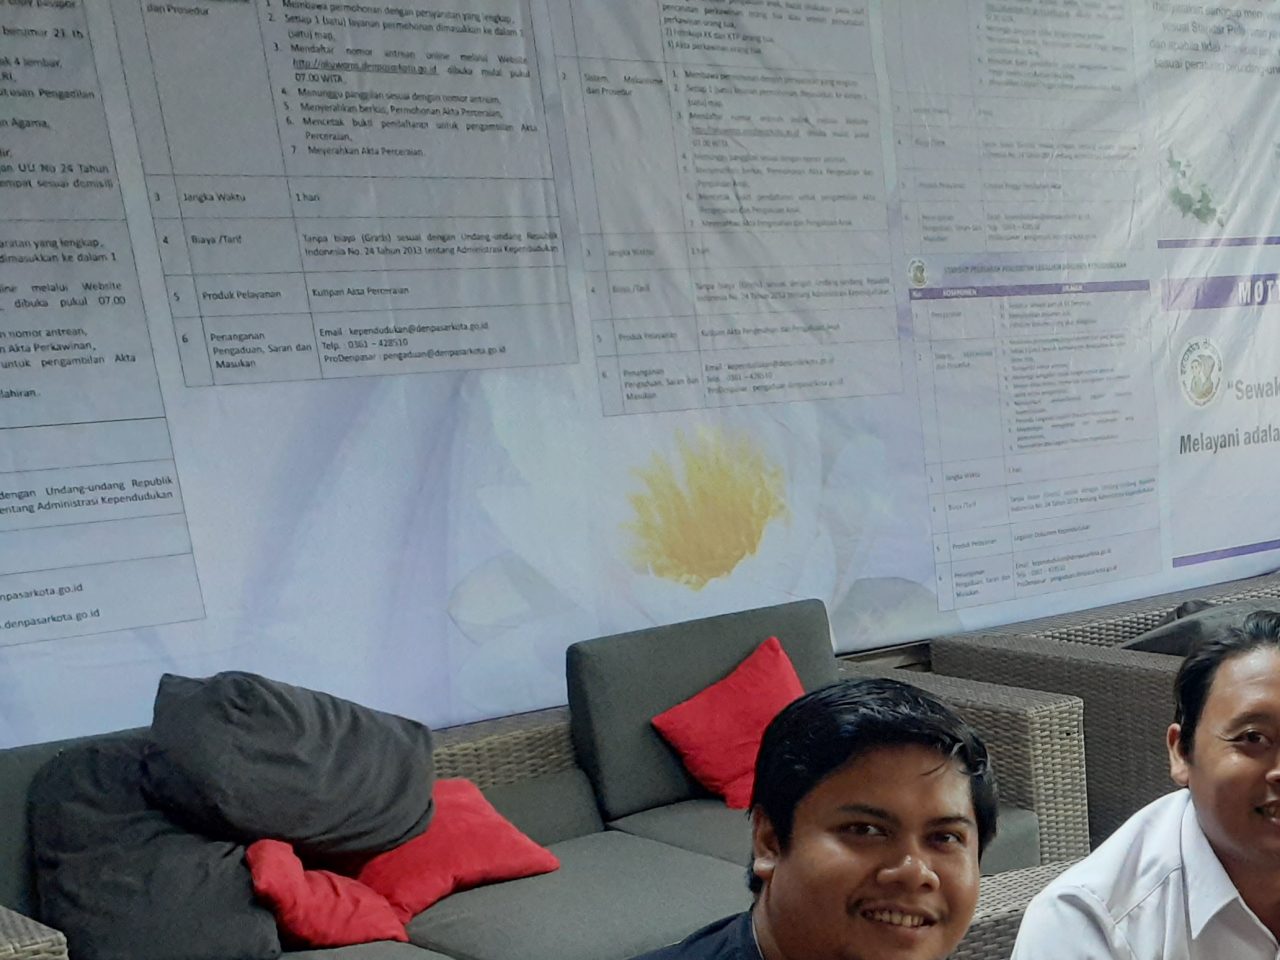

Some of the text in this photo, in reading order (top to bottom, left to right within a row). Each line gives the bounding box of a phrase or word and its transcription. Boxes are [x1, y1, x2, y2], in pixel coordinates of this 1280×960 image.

[38, 88, 95, 100] Pengadilan
[79, 164, 109, 174] Tahun
[34, 241, 58, 250] yang
[62, 252, 107, 262] ke dalam
[31, 282, 122, 292] melalui Website
[202, 291, 235, 301] Produk
[237, 290, 282, 301] Pelayanan
[14, 296, 126, 309] dibuka pukul 07.00
[8, 330, 42, 338] nomor
[210, 332, 265, 343] Penanganan
[320, 328, 342, 337] Email
[8, 342, 97, 353] Akta Perkawinan,
[268, 344, 293, 353] Saran
[296, 343, 312, 352] dan
[2, 354, 136, 369] untuk pengambilan Akta
[215, 358, 256, 369] Masukan
[1179, 428, 1240, 455] Melayani
[45, 480, 125, 496] Undang-undang
[131, 476, 173, 488] Republik
[37, 490, 173, 511] Administrasi Kependudukan
